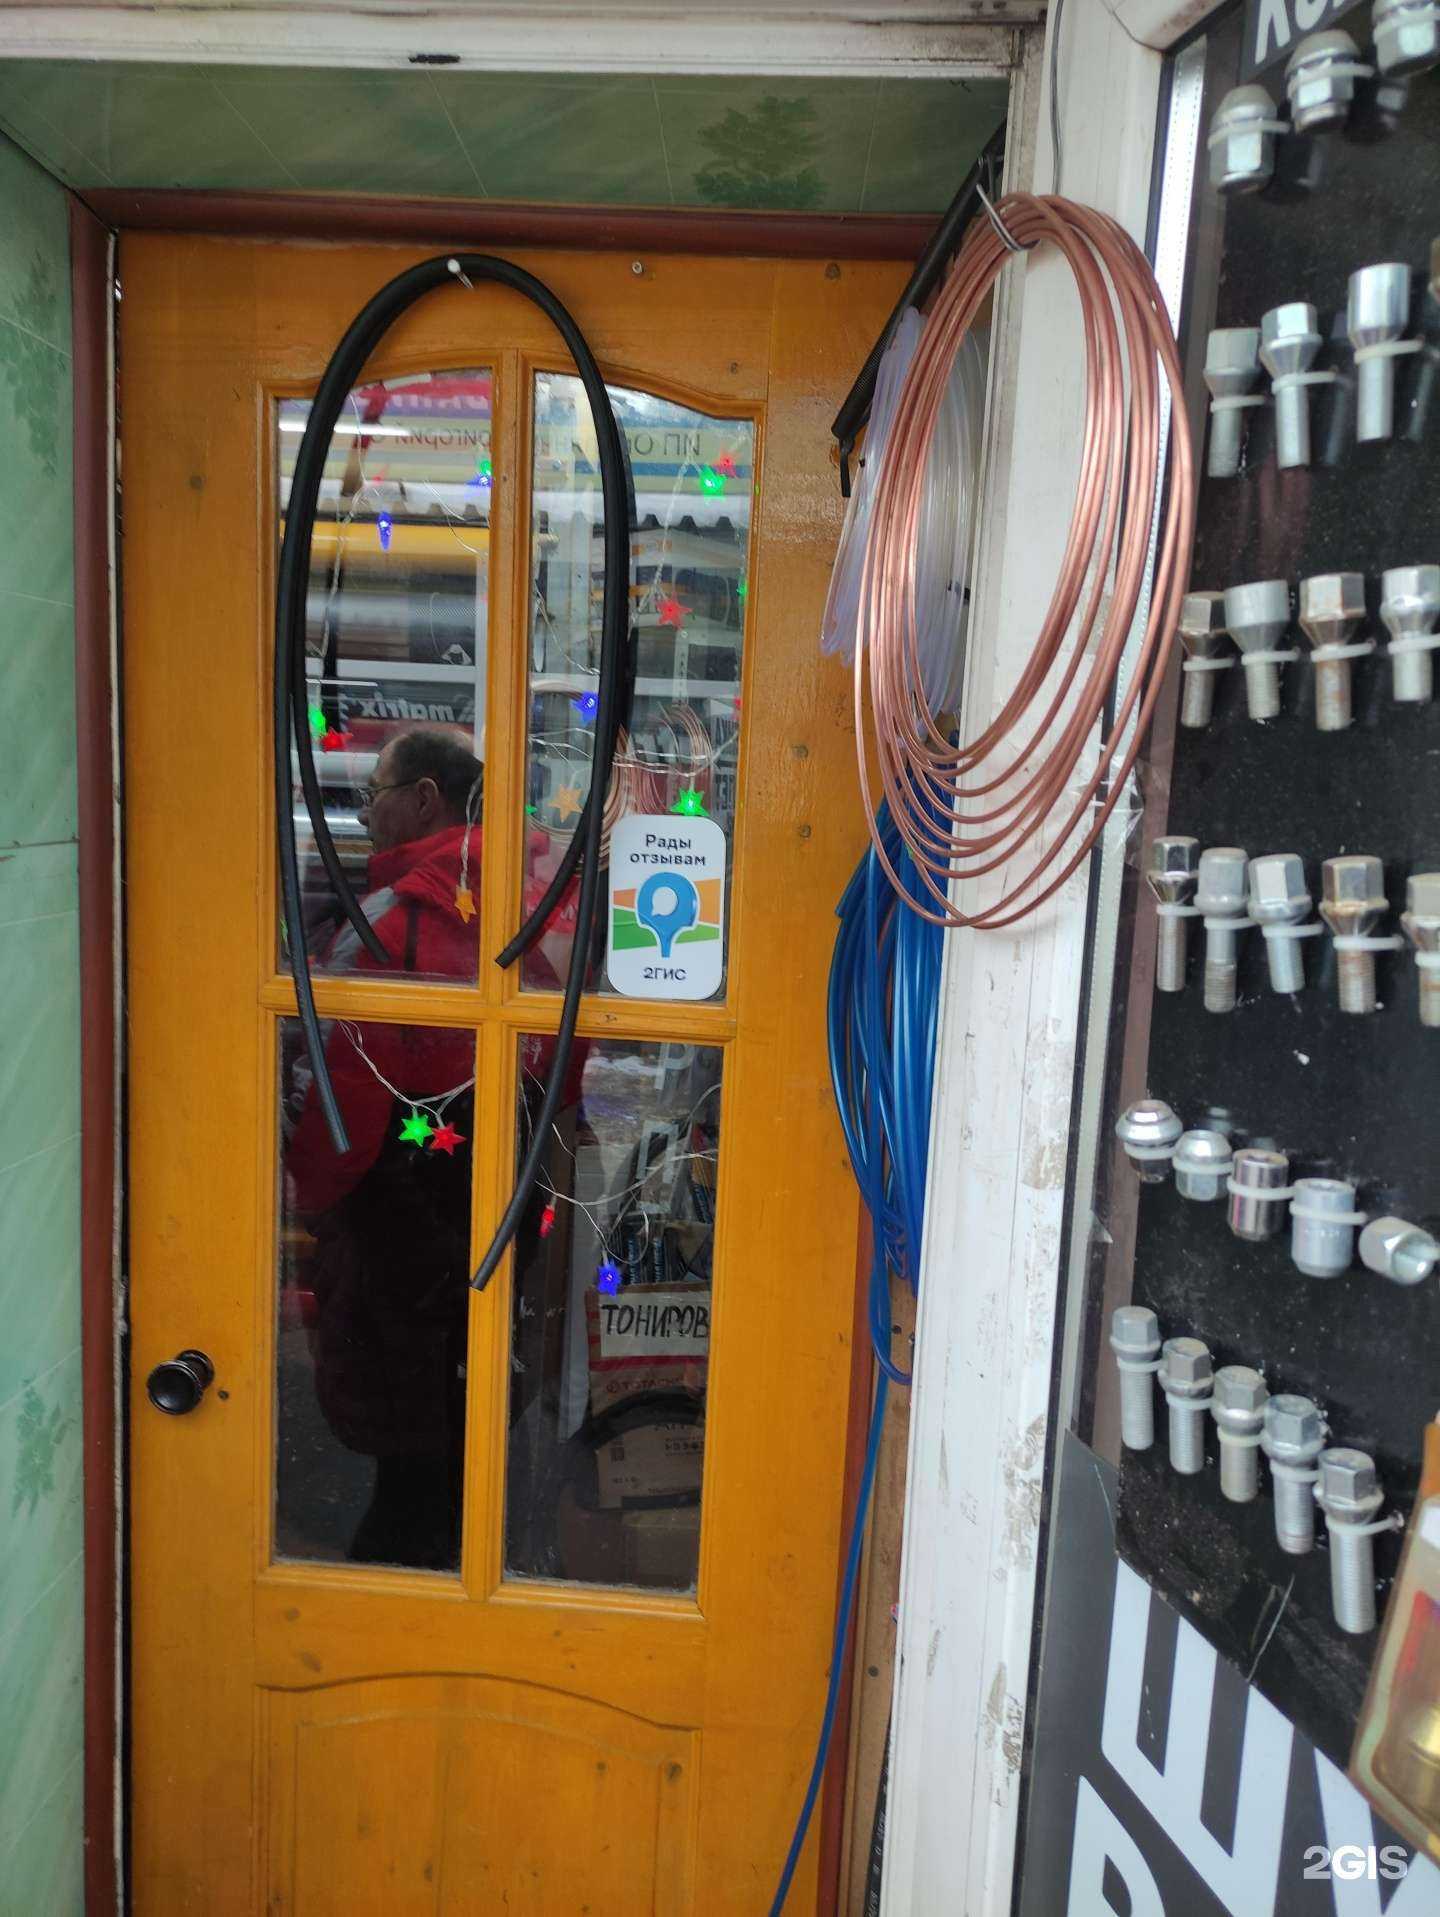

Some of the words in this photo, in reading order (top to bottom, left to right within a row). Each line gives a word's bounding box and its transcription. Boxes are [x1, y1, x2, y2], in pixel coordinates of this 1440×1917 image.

[646, 834, 691, 850] Рады
[630, 854, 706, 866] отзывам
[643, 967, 687, 981] 2ГИС
[601, 1303, 710, 1338] ТОНИРОВ
